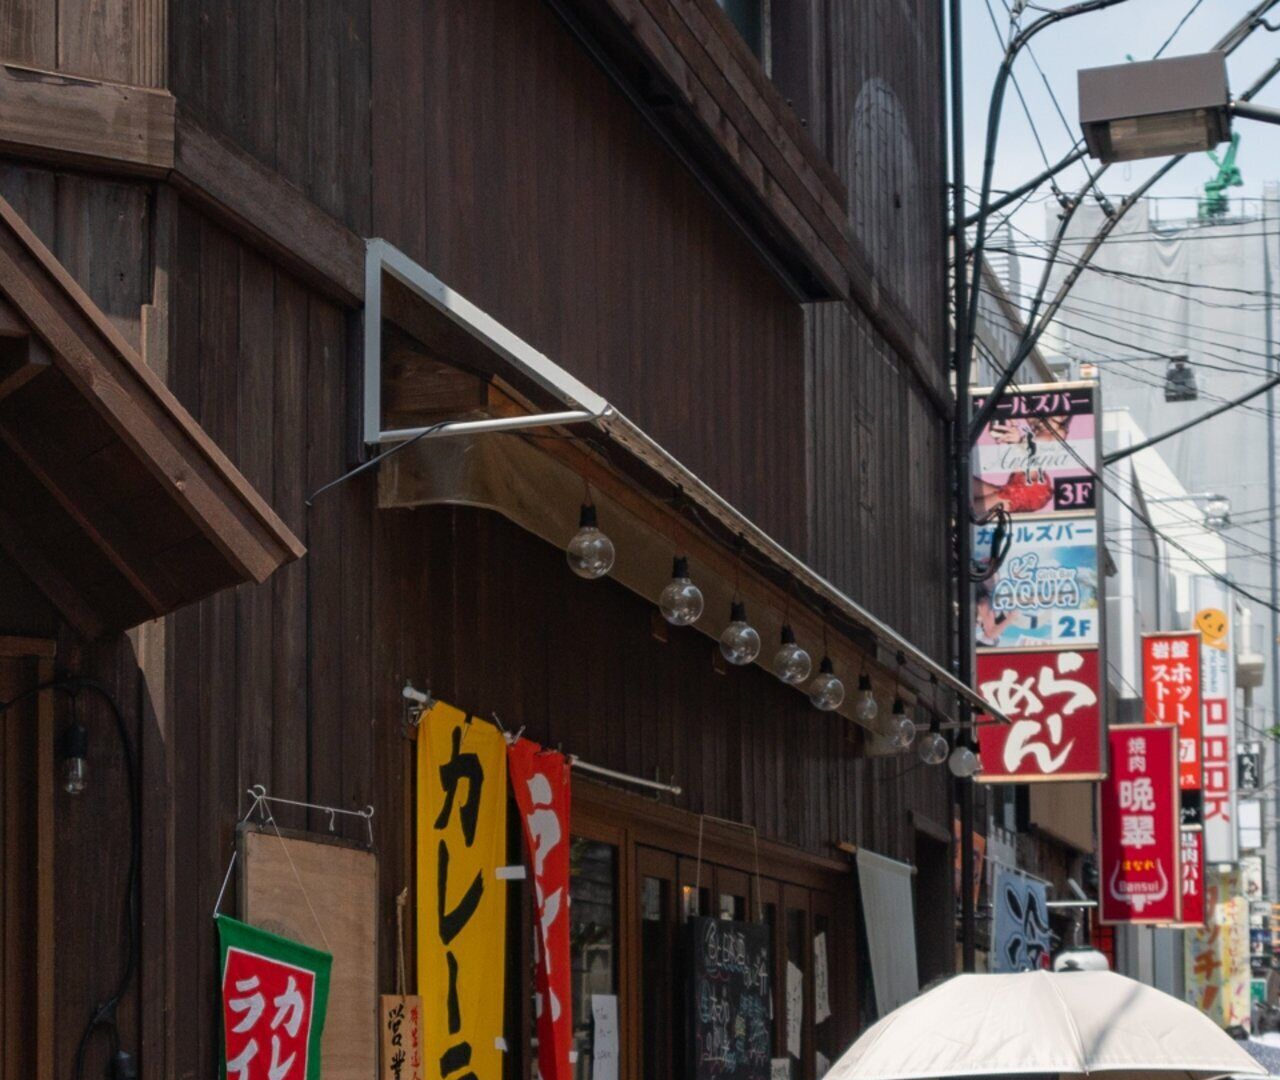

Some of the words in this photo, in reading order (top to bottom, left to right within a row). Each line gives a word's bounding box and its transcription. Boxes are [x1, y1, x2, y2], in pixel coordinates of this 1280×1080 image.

[1059, 482, 1092, 505] 3F
[993, 579, 1080, 610] AQUA
[1058, 616, 1091, 638] 2F
[1127, 737, 1147, 773] 焼肉
[1119, 777, 1156, 849] 晩翠
